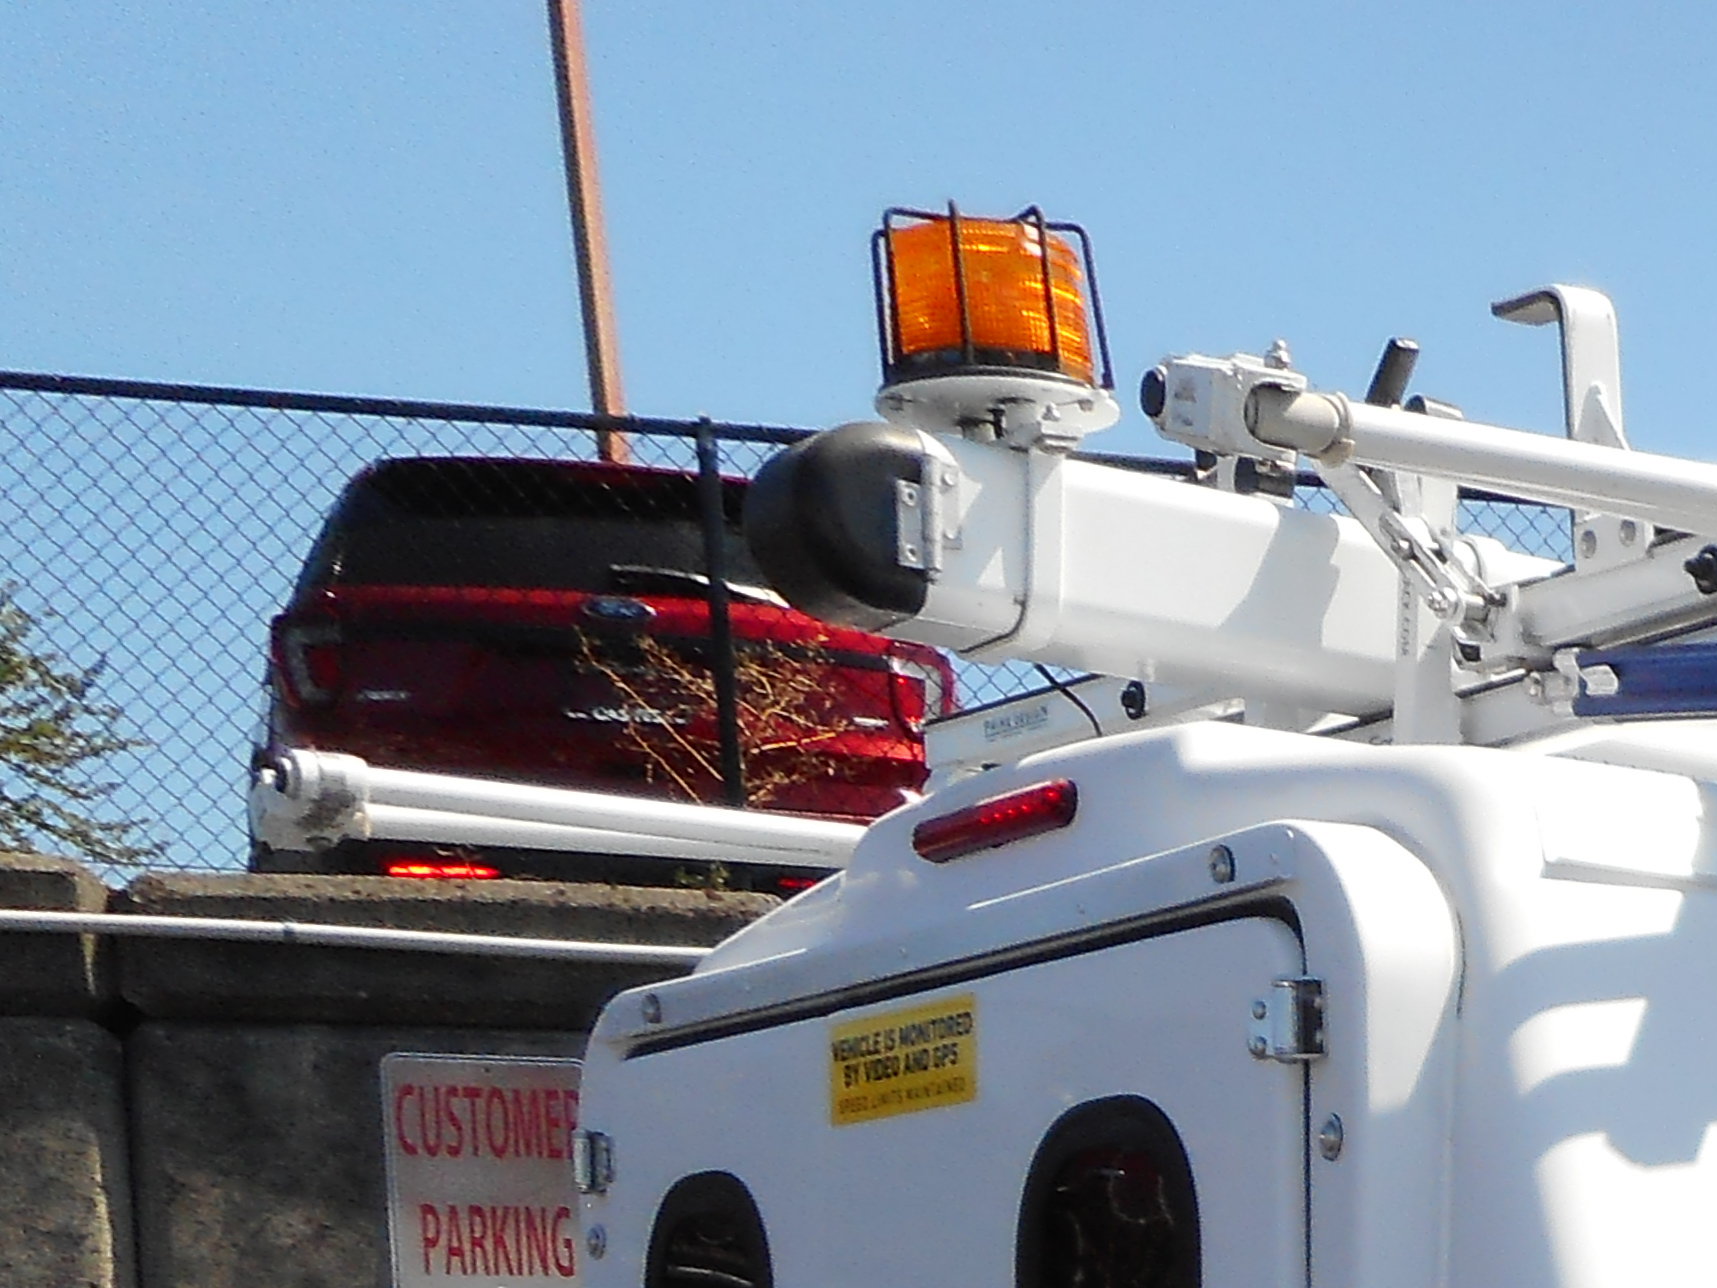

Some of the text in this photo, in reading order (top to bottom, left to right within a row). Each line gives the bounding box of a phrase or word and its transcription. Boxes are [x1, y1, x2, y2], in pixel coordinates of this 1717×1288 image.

[832, 1011, 973, 1062] VEHICLE IS MONITORED
[844, 1042, 959, 1088] BY VIDEO AND GPS
[394, 1083, 579, 1160] CUSTOMER
[419, 1203, 576, 1277] PARKING
